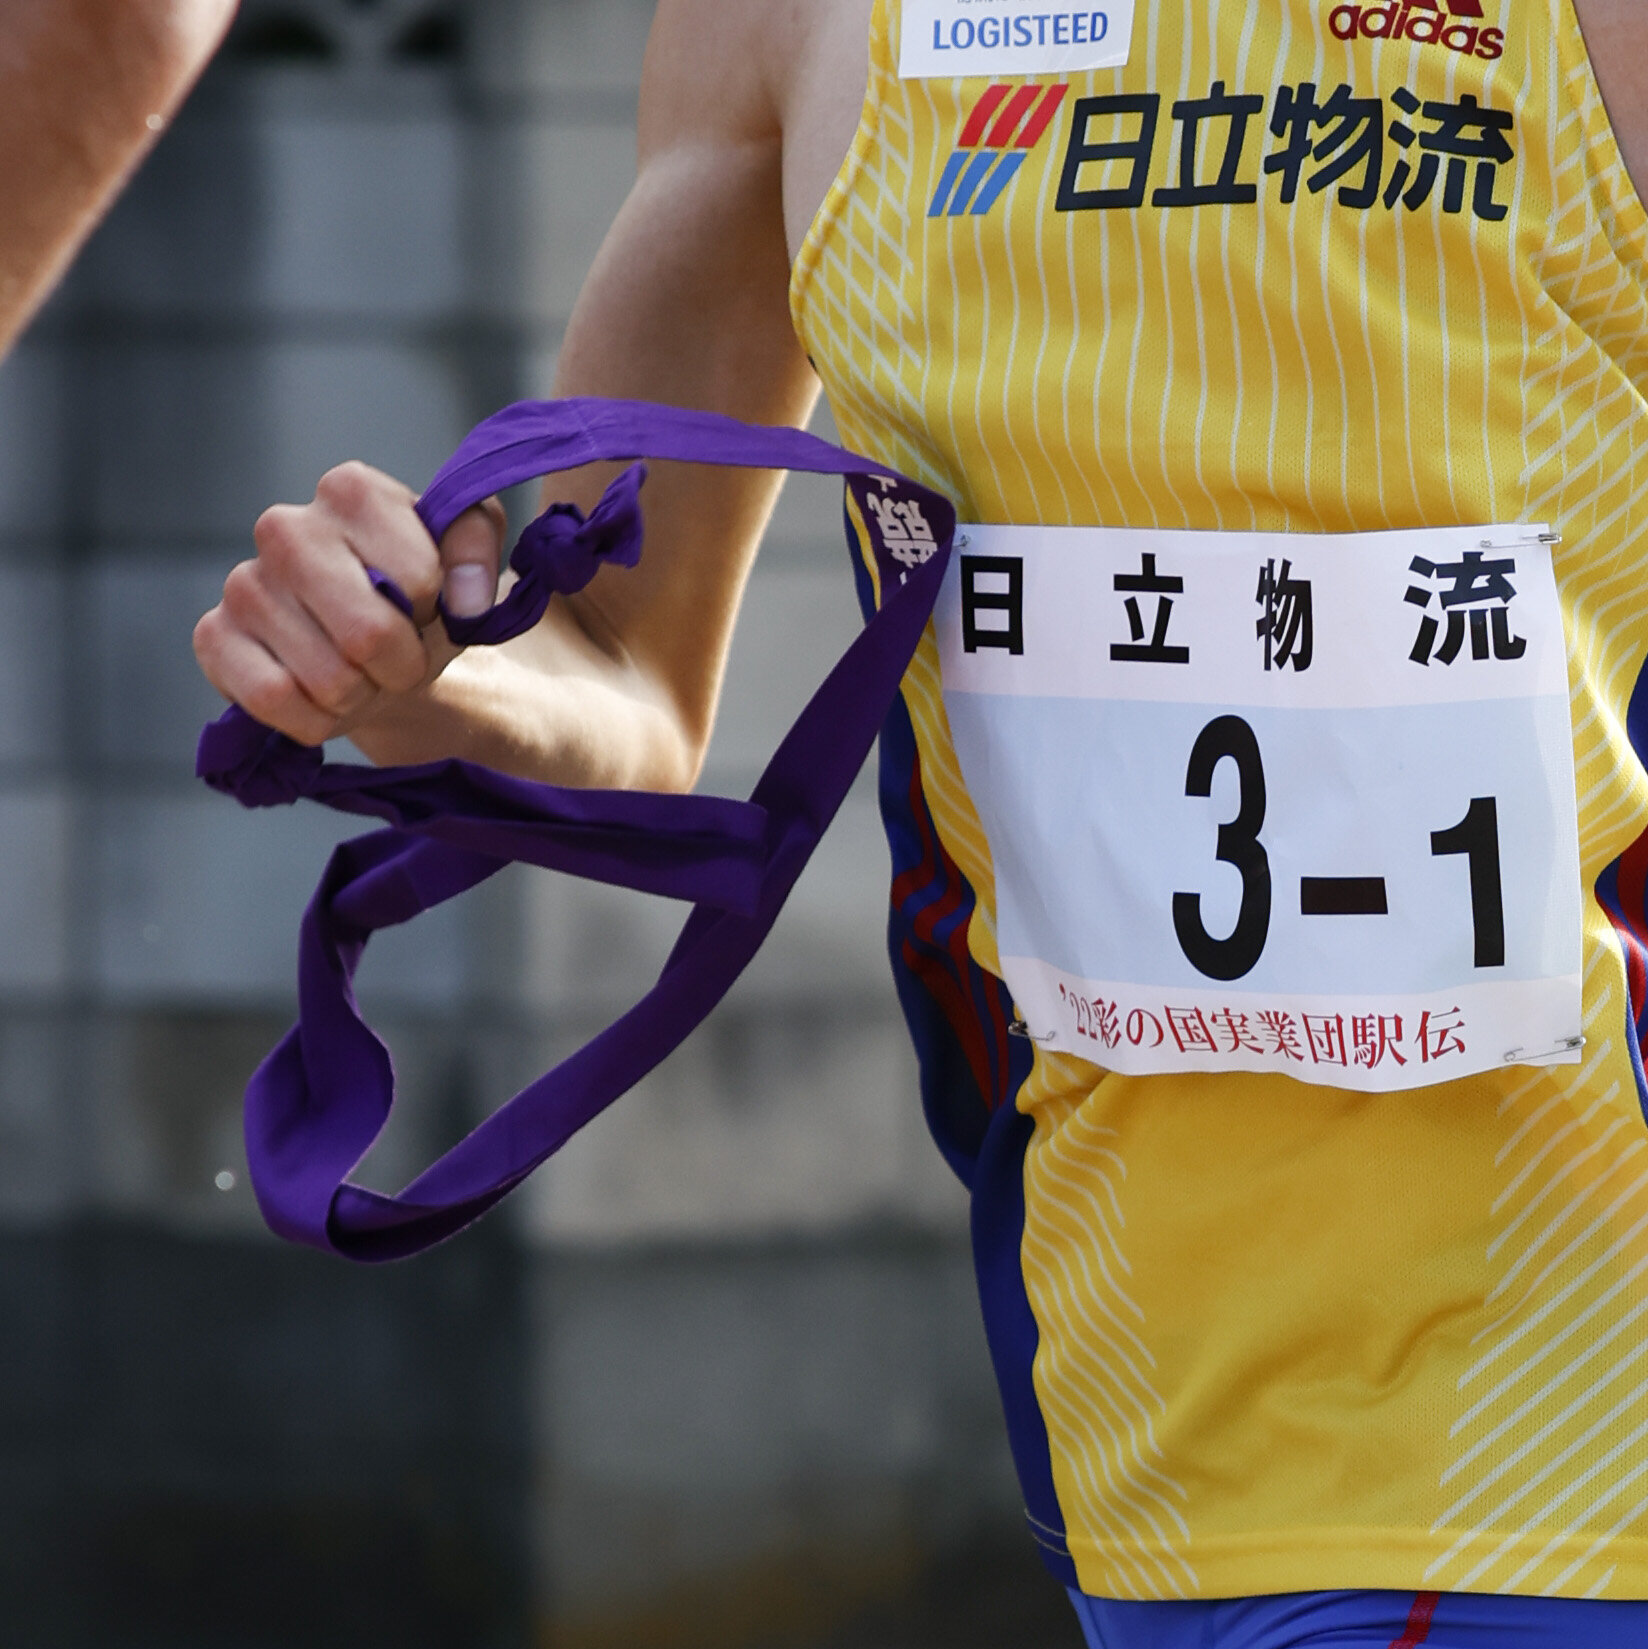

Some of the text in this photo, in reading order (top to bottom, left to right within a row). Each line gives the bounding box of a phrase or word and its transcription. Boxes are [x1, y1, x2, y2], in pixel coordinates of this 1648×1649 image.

[932, 11, 1109, 50] LOGISTEED
[1054, 80, 1515, 222] 日立物流
[959, 551, 1527, 673] 日立物流
